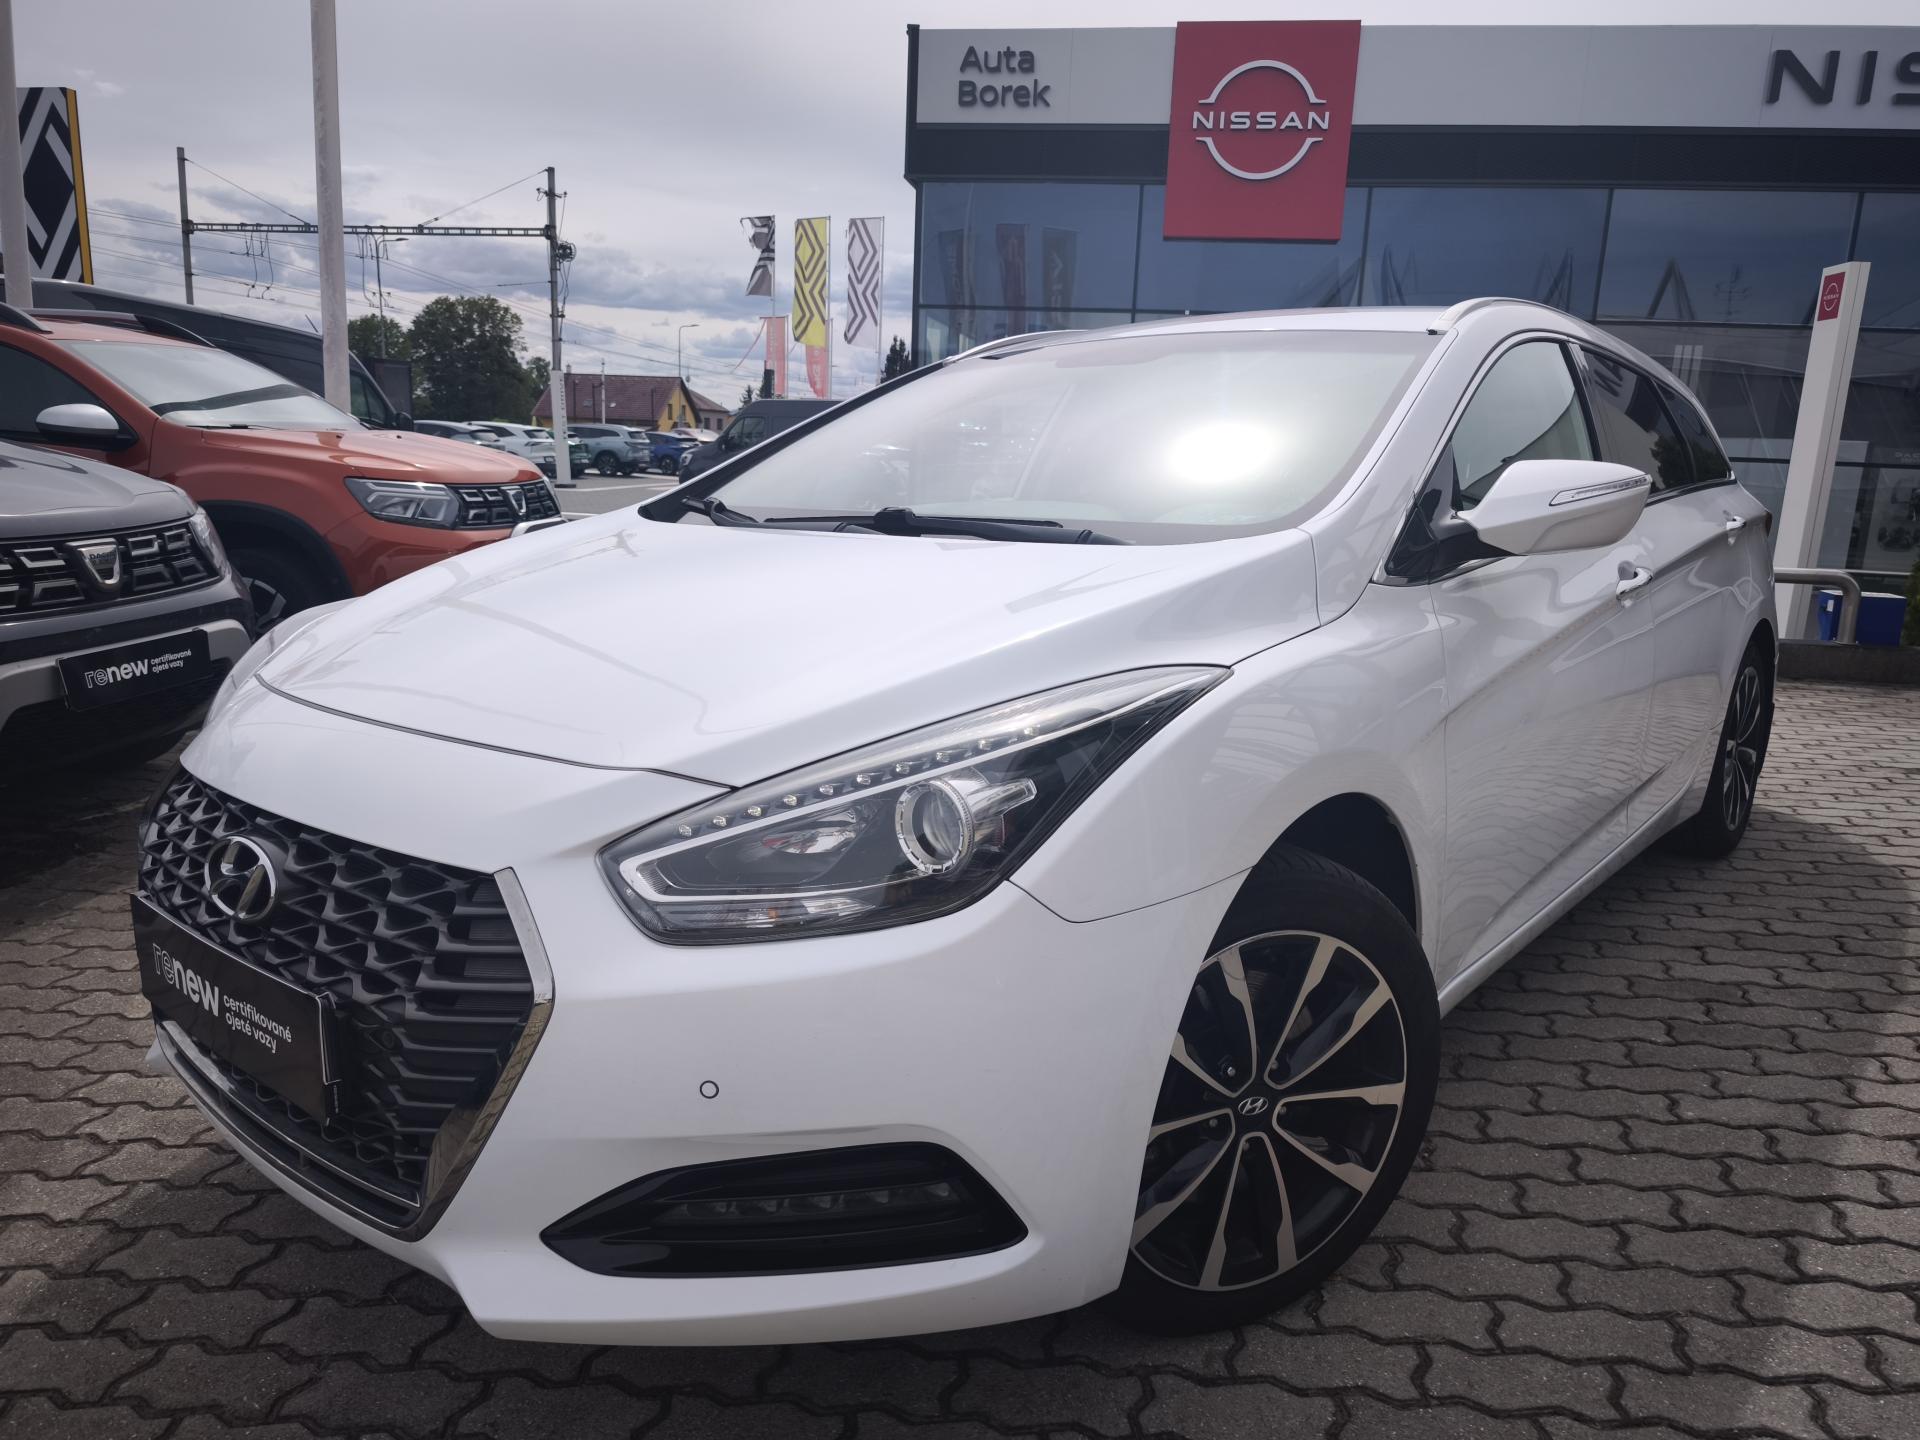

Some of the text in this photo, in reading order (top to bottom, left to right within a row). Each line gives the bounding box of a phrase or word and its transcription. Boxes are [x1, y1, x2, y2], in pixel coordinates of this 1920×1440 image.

[960, 45, 1035, 73] Auta
[958, 78, 1051, 108] Borek
[1192, 111, 1330, 130] NISSAN
[150, 648, 192, 665] certifikované
[152, 659, 184, 673] ojeté vozy
[84, 659, 149, 689] renew
[152, 943, 220, 1017] renew
[223, 994, 292, 1043] certifikované
[225, 1011, 277, 1054] ojeté vozy
